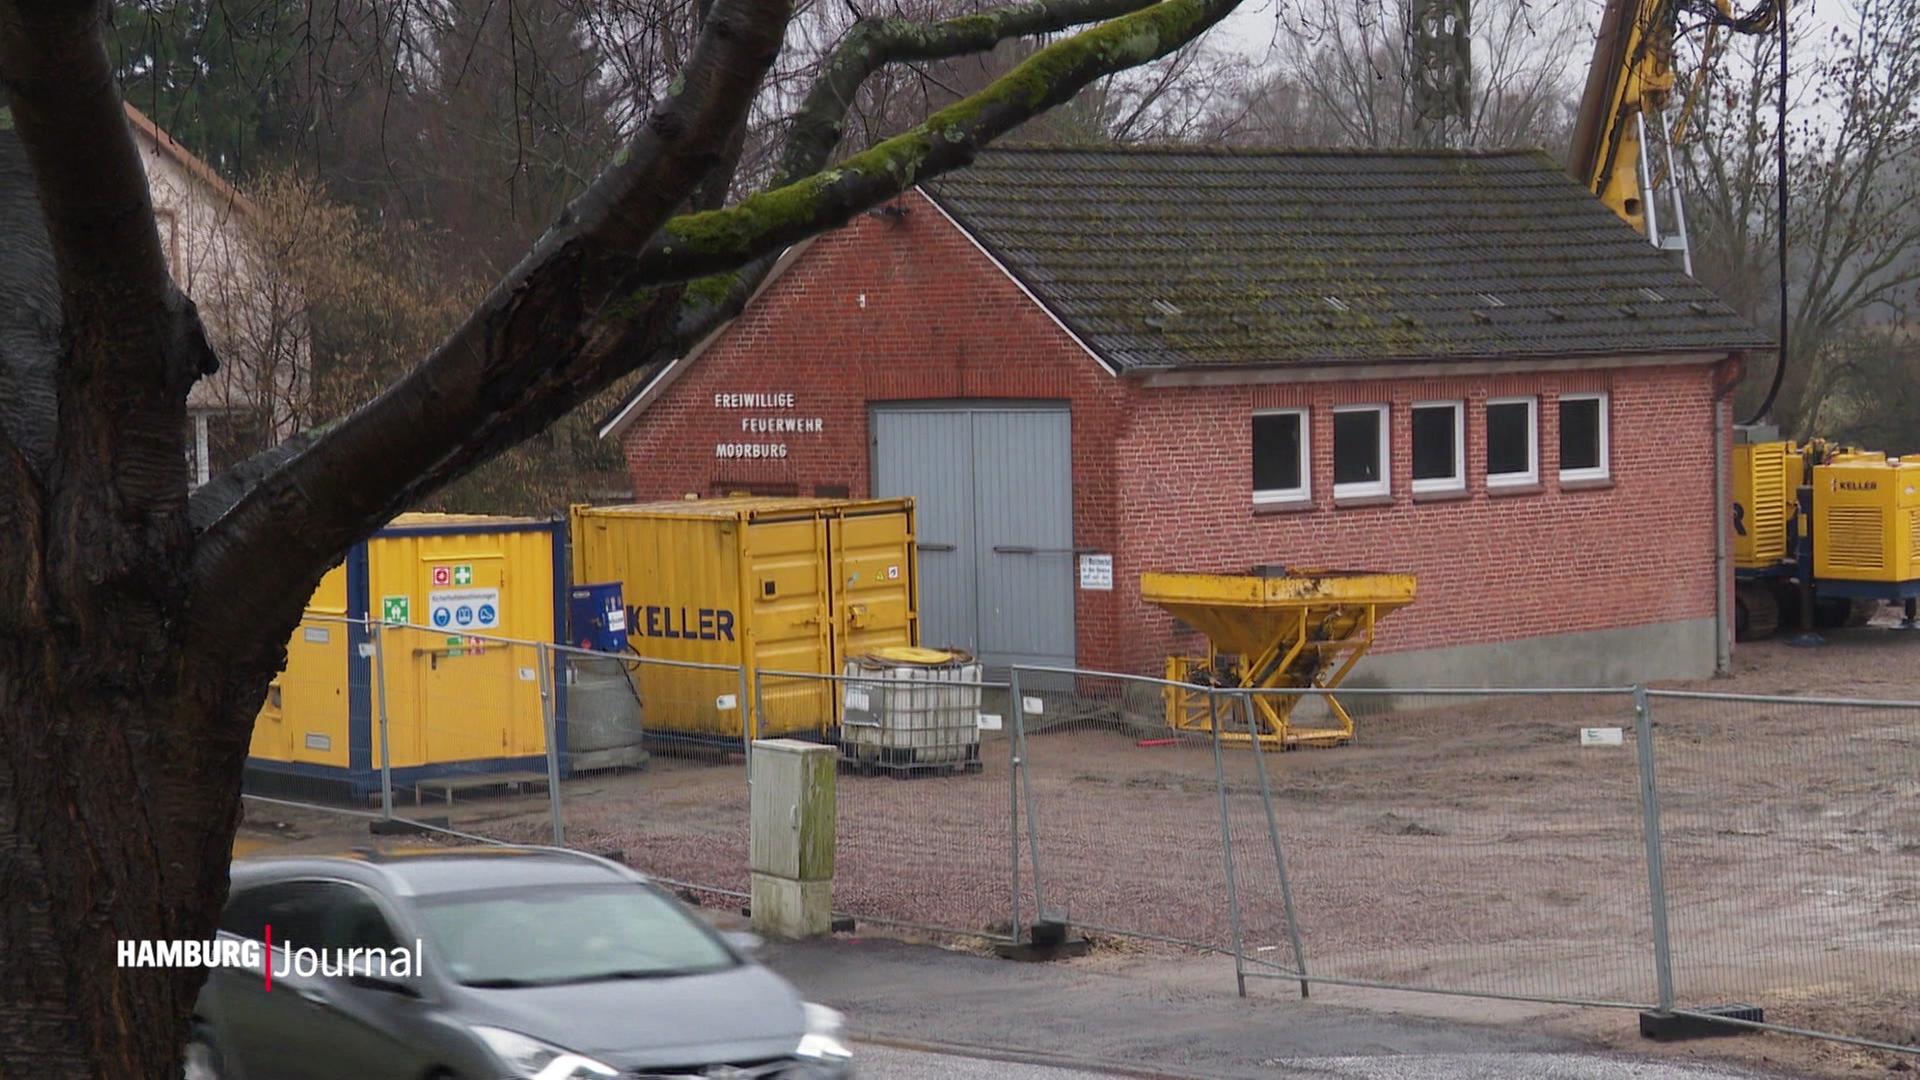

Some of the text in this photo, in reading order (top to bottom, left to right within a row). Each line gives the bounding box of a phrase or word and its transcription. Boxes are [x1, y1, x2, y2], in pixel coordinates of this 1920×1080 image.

[715, 393, 795, 408] FREIWILLIGE
[742, 418, 823, 432] FEUERWEHR
[716, 443, 788, 458] MOORBURG
[1839, 481, 1878, 491] KELLER
[626, 605, 735, 641] KELLER
